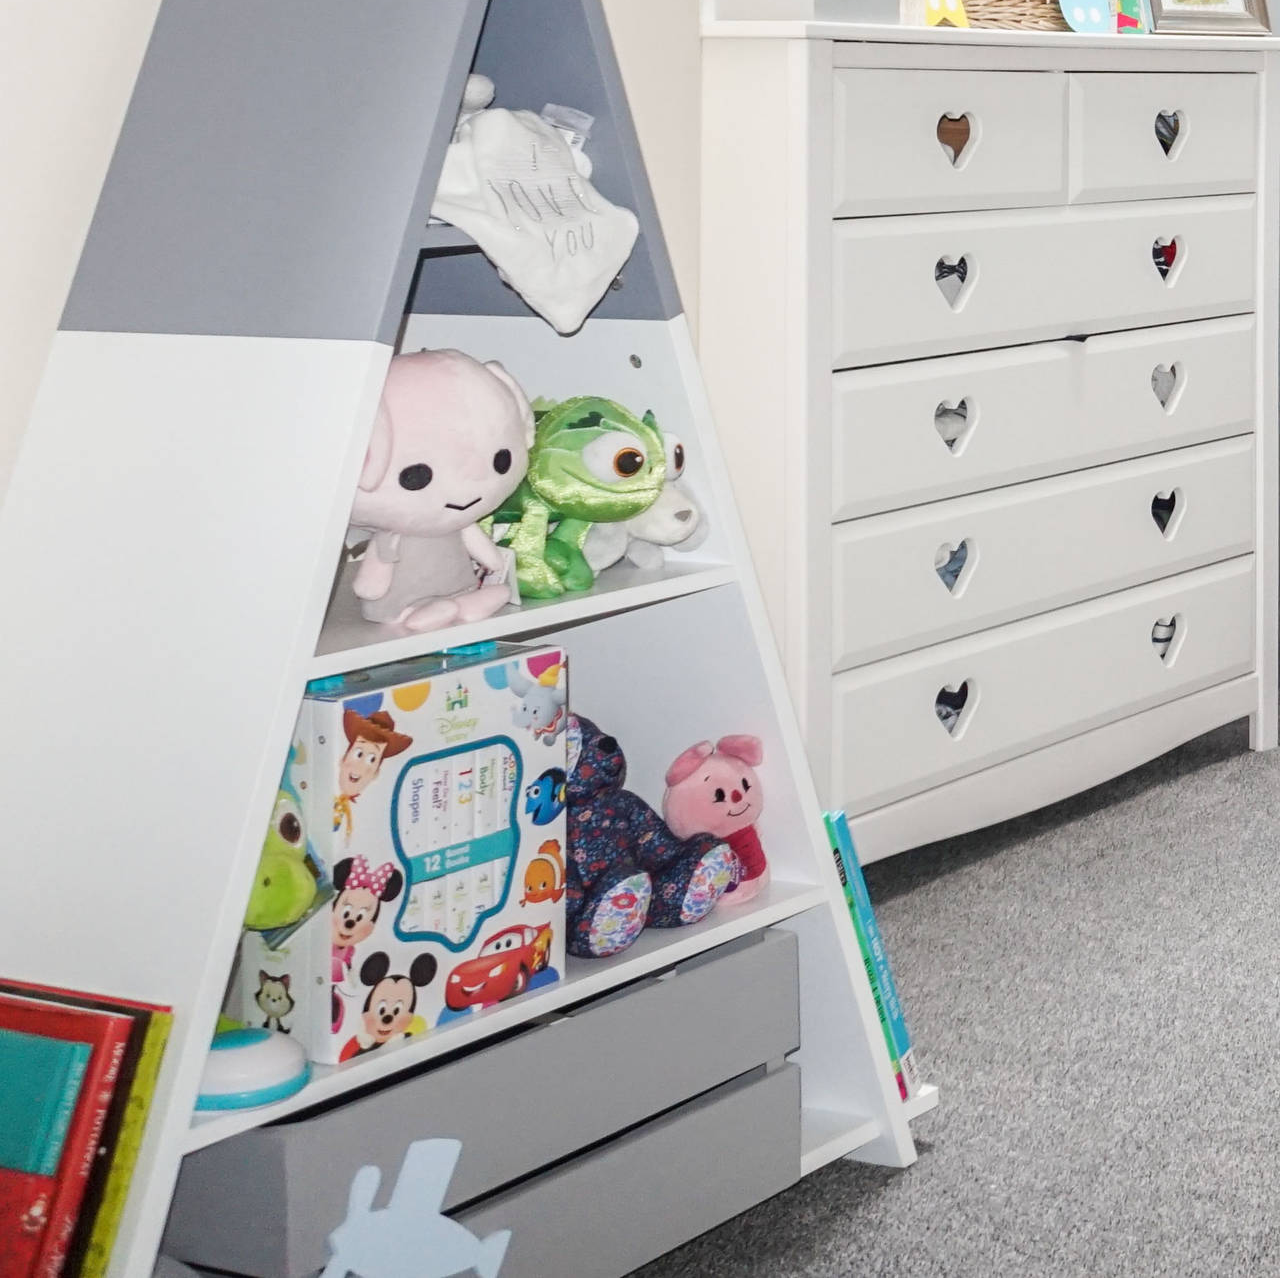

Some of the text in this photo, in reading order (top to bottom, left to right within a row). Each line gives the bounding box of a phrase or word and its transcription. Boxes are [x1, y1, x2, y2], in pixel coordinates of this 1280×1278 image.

[543, 221, 595, 265] YOU
[475, 766, 489, 796] Body
[408, 777, 424, 824] Shapes
[424, 854, 442, 873] 12
